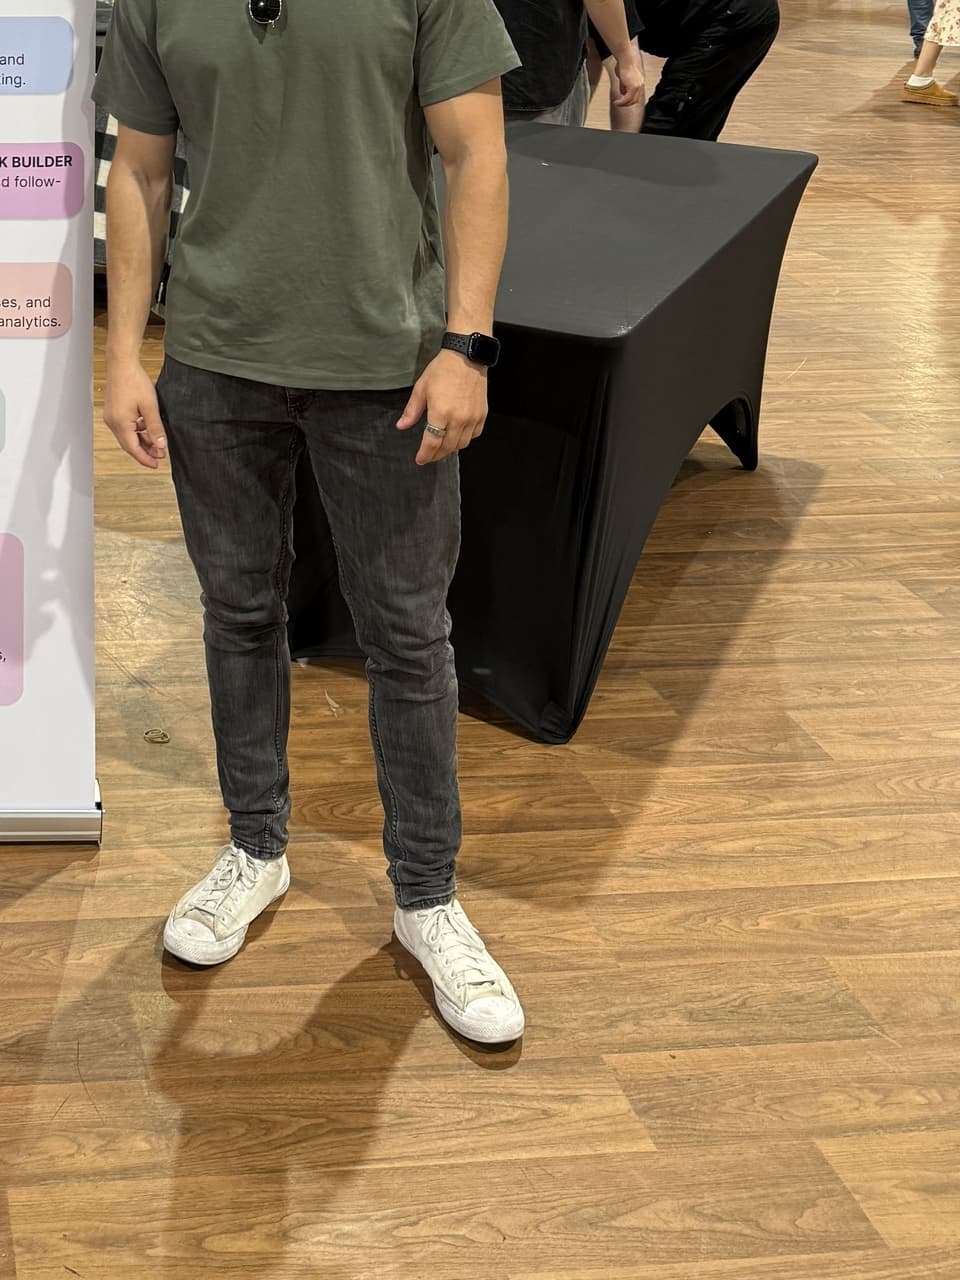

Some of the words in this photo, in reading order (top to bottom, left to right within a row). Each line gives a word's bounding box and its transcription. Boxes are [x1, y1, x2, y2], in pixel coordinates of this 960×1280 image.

[0, 53, 24, 66] and
[12, 155, 72, 168] BUILDER
[14, 175, 61, 188] follow-
[26, 296, 51, 308] and
